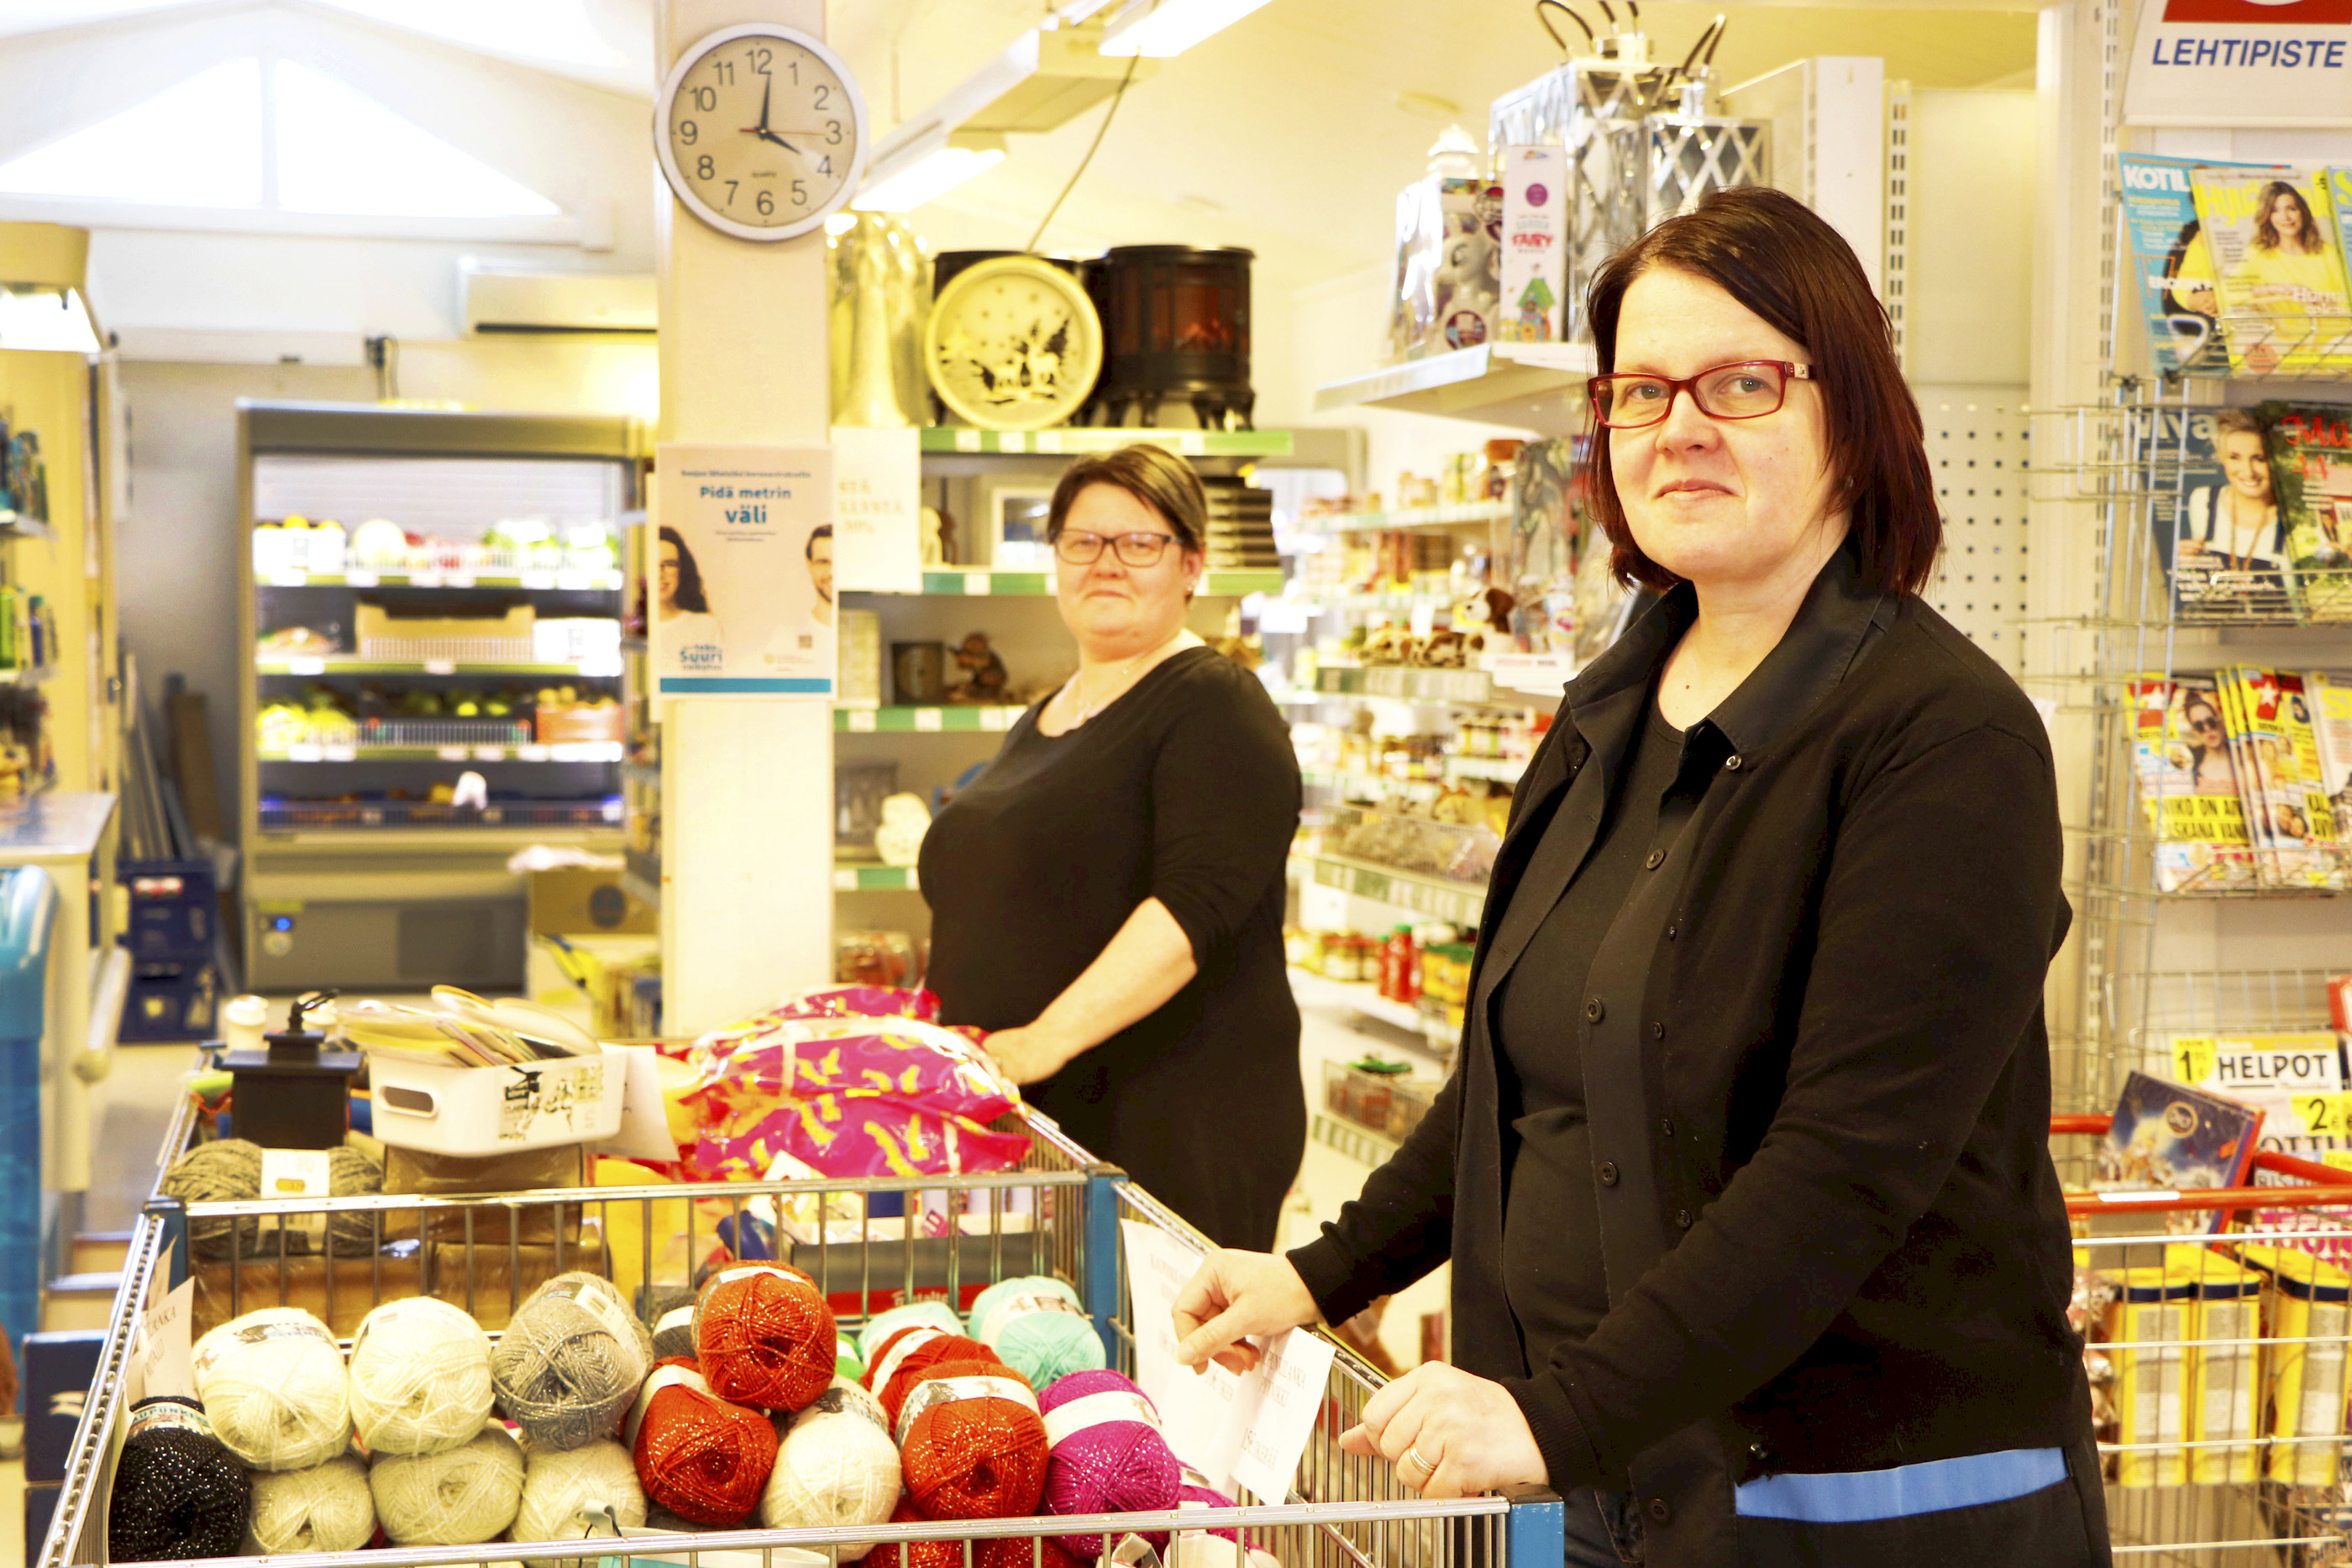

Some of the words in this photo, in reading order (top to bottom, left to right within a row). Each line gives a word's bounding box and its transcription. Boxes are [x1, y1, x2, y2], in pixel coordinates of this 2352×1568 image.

[745, 49, 773, 75] 12
[2152, 38, 2346, 67] LEHTIPISTE
[713, 61, 734, 86] 11
[789, 61, 799, 86] 1
[690, 87, 717, 112] 10
[813, 85, 829, 110] 2
[680, 121, 698, 145] 9
[825, 120, 843, 144] 3
[697, 155, 715, 181] 8
[816, 155, 832, 178] 4
[725, 181, 739, 206] 7
[756, 191, 774, 216] 6
[791, 180, 807, 205] 5
[700, 485, 733, 499] Pidä
[739, 486, 791, 499] metrin
[725, 504, 767, 524] väli
[2218, 1054, 2328, 1081] HELPOT
[2308, 1099, 2328, 1130] 2
